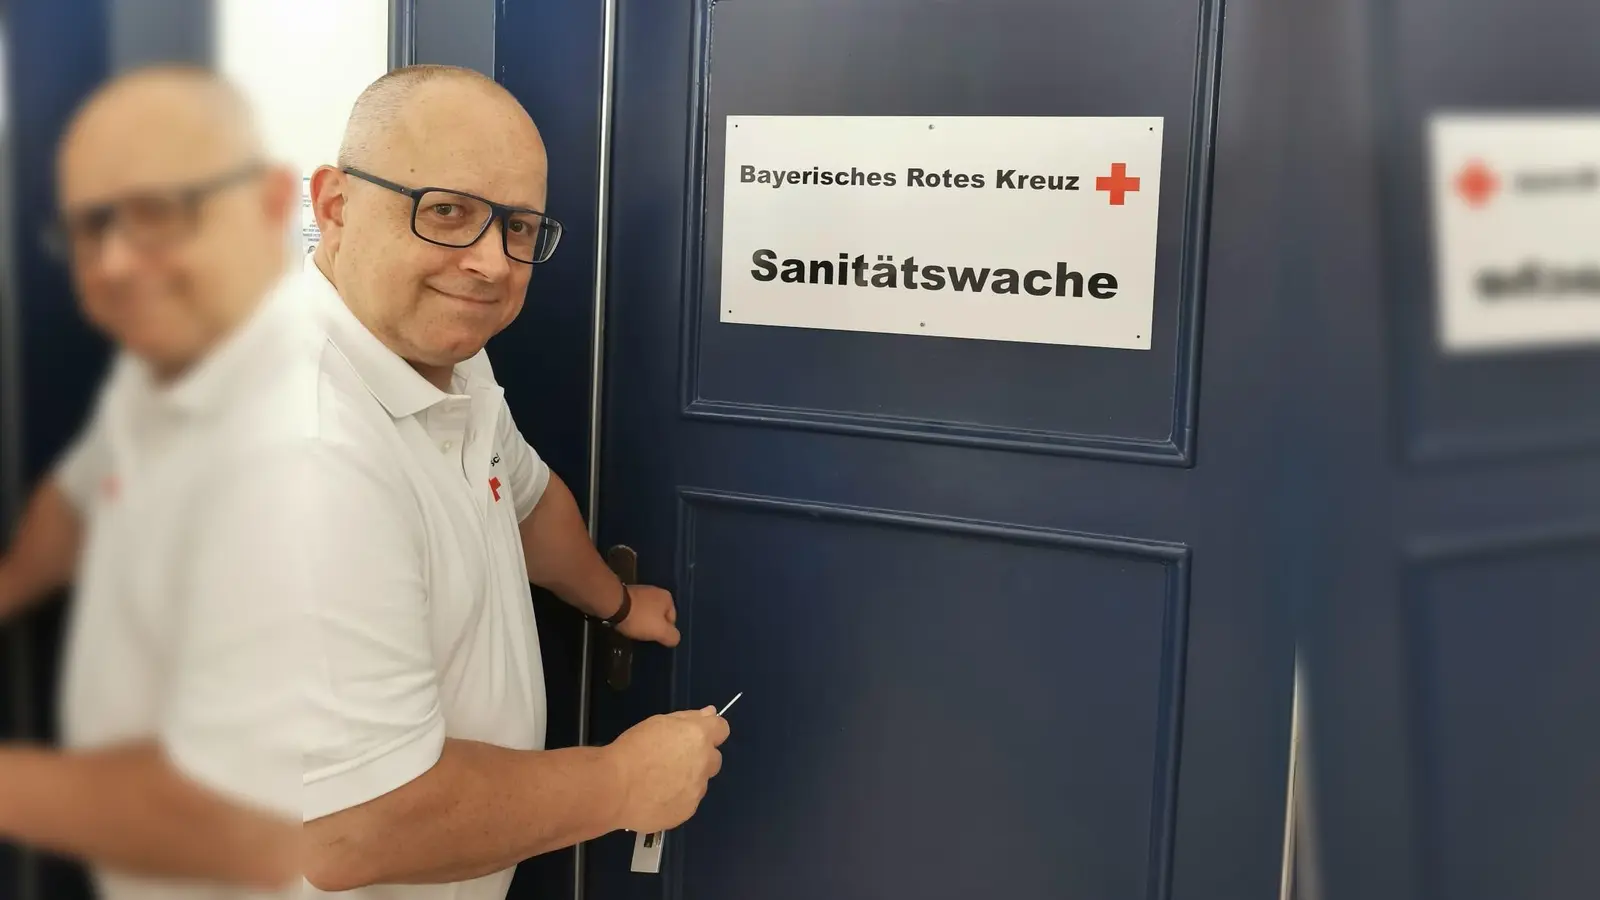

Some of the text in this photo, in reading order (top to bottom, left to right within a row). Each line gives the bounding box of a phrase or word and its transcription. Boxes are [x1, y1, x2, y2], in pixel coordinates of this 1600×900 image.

[739, 164, 1081, 191] Bayerisches Rotes Kreuz
[750, 248, 1119, 300] Sanitätswache
